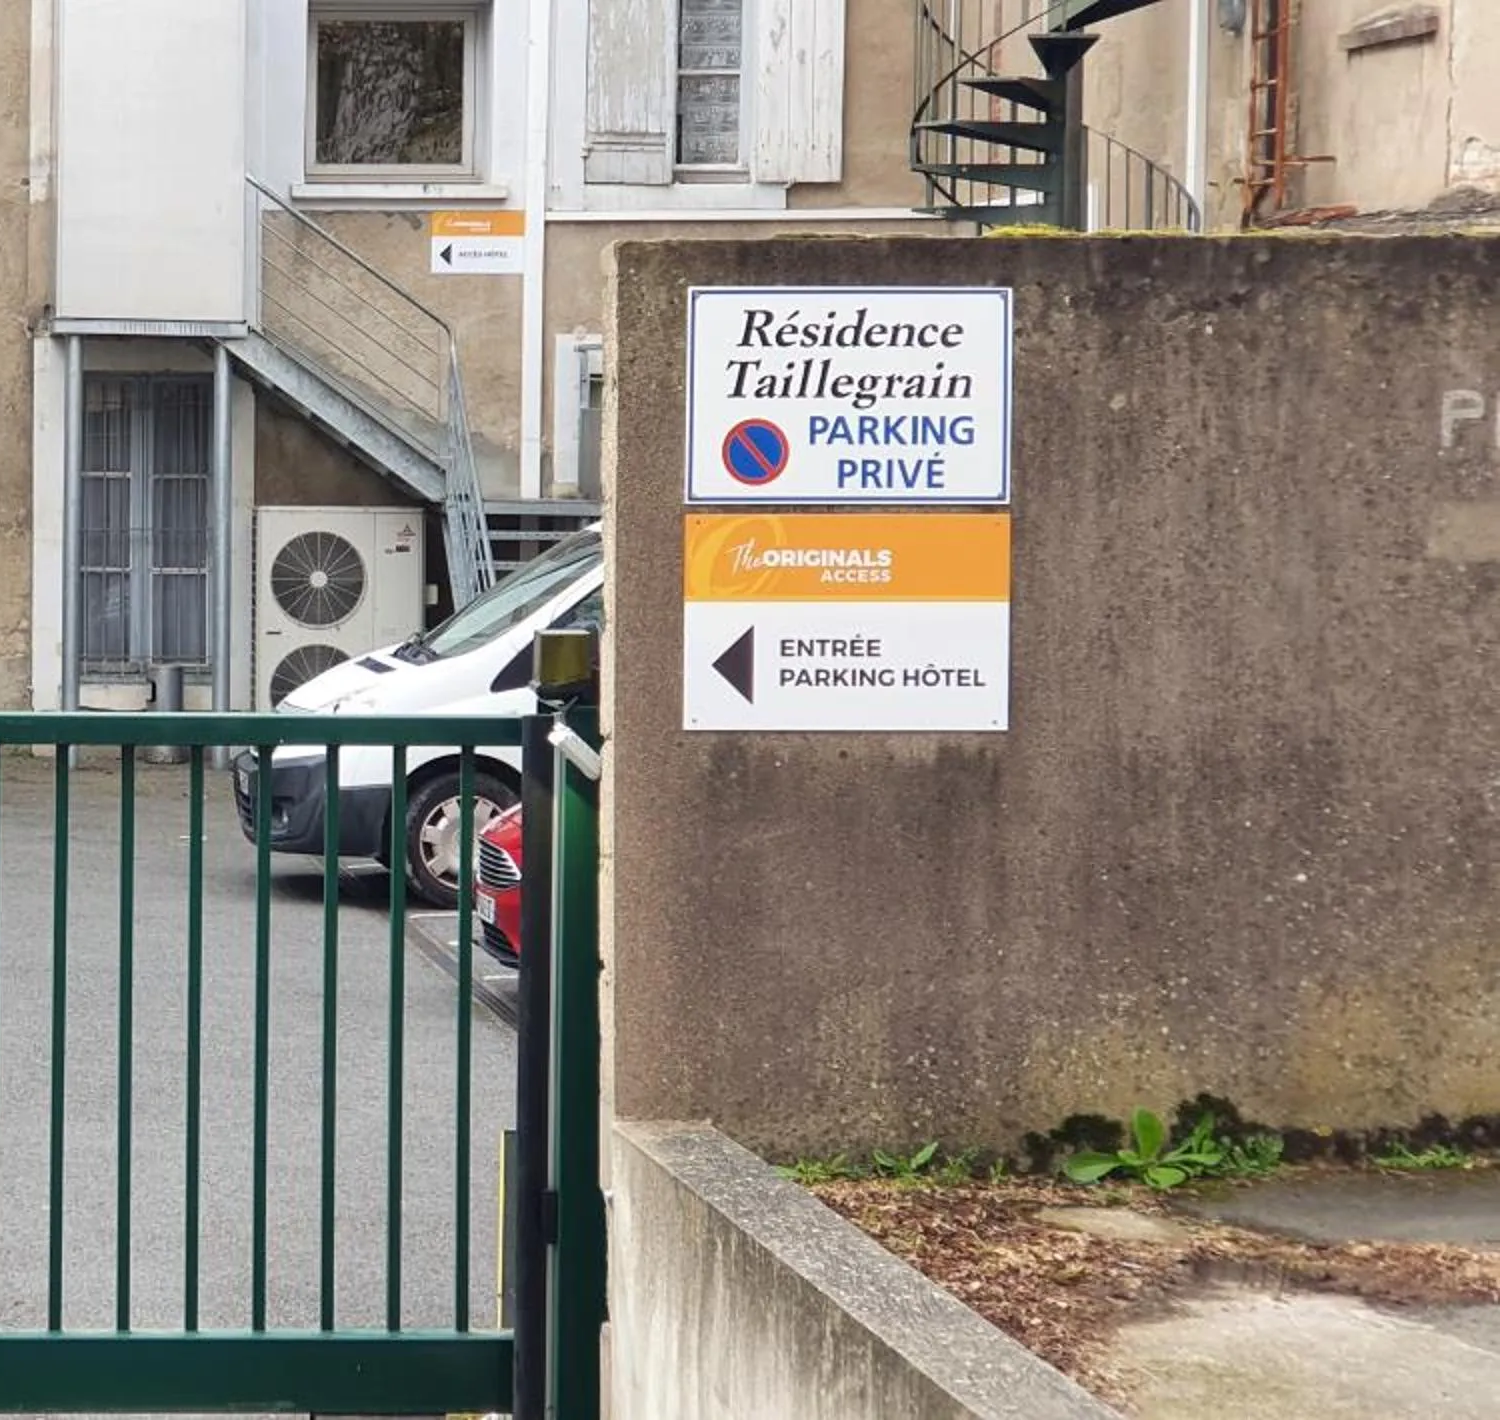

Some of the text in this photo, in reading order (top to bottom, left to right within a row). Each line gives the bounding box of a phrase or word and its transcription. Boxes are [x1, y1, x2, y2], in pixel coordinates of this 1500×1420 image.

[736, 308, 964, 348] Résidence
[726, 358, 973, 409] Taillegrain
[809, 415, 974, 445] PARKING
[837, 452, 945, 489] PRIVÉ
[763, 549, 892, 567] ORIGINALS
[820, 569, 892, 583] ACCESS
[779, 634, 881, 657] ENTRÉE
[779, 663, 986, 687] PARKING HÔTEL
